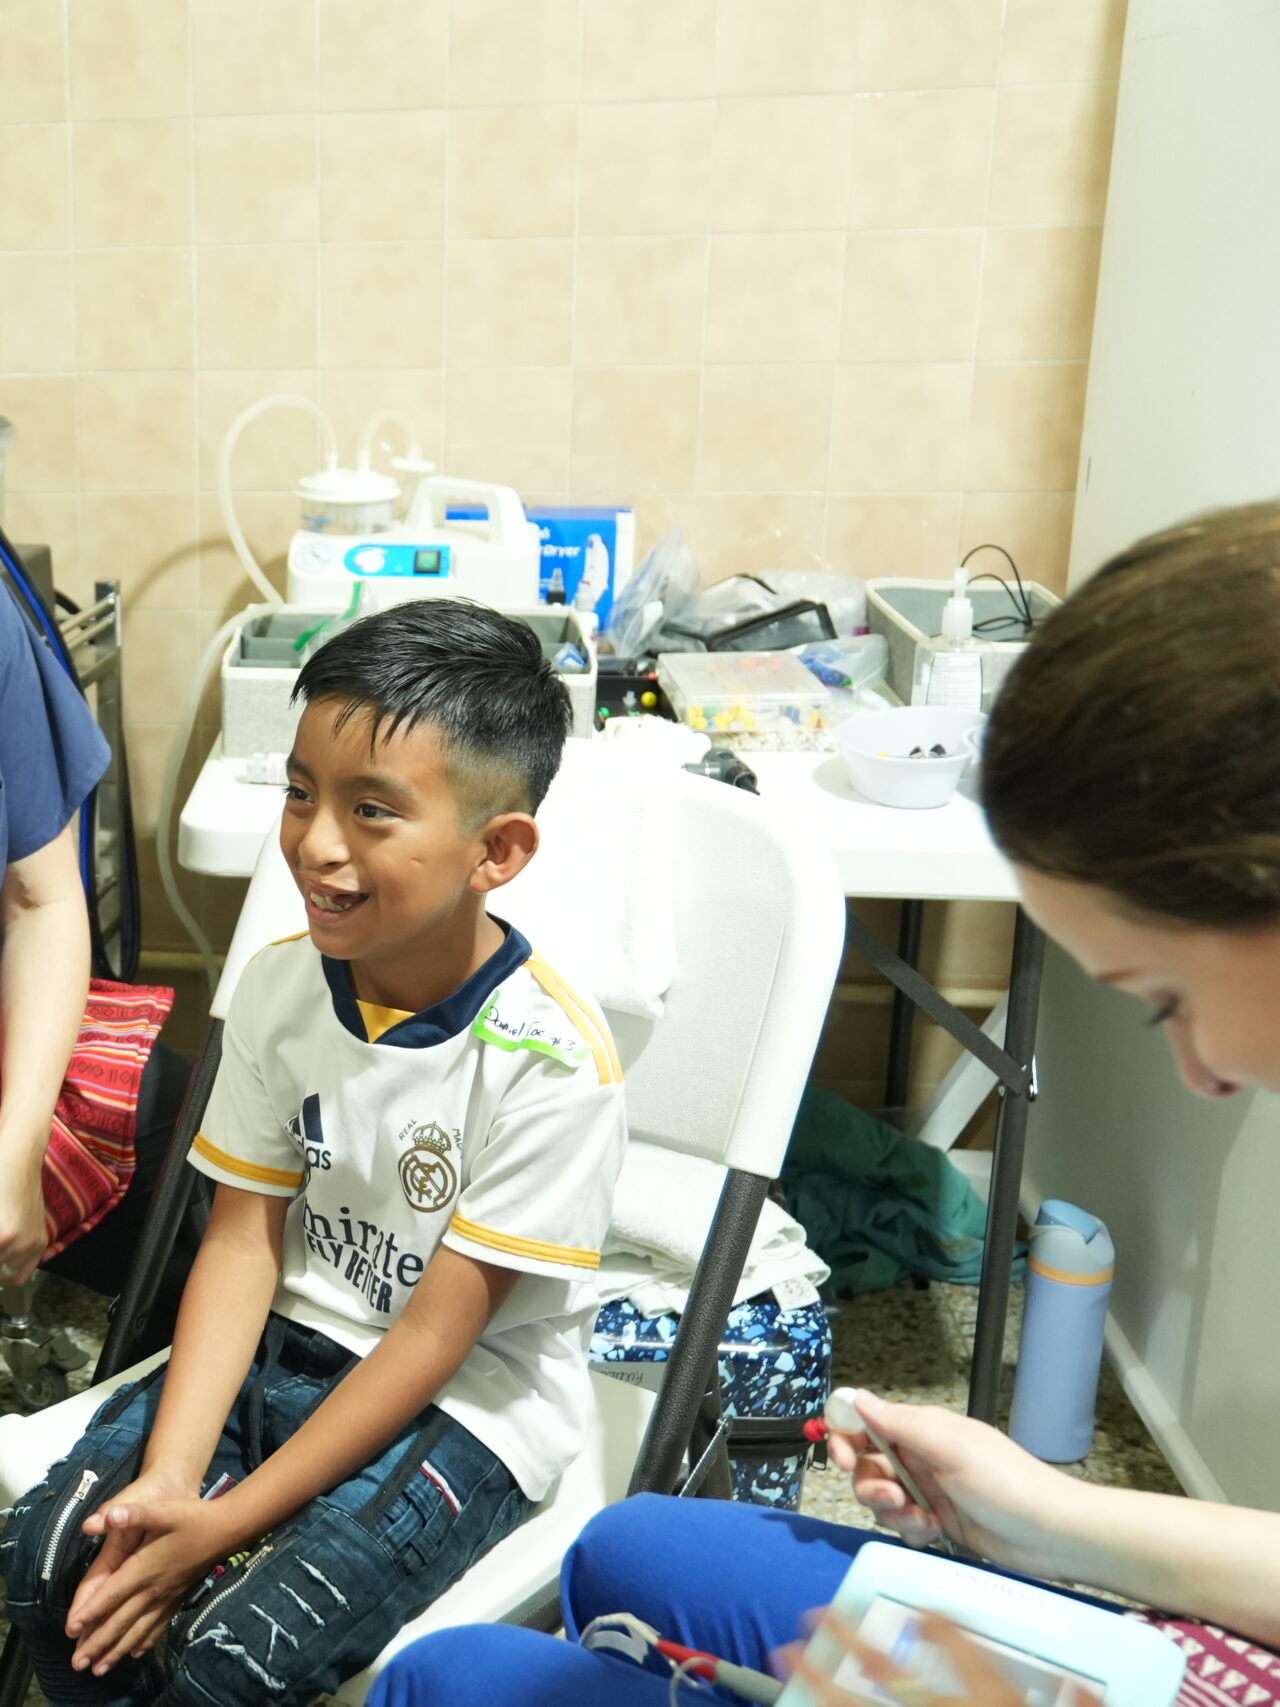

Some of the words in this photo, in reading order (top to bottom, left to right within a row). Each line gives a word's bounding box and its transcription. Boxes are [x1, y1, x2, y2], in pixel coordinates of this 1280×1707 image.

[398, 1118, 418, 1141] REAL
[303, 1202, 424, 1287] mirate
[306, 1232, 344, 1268] FLY
[344, 1249, 393, 1314] BETTER
